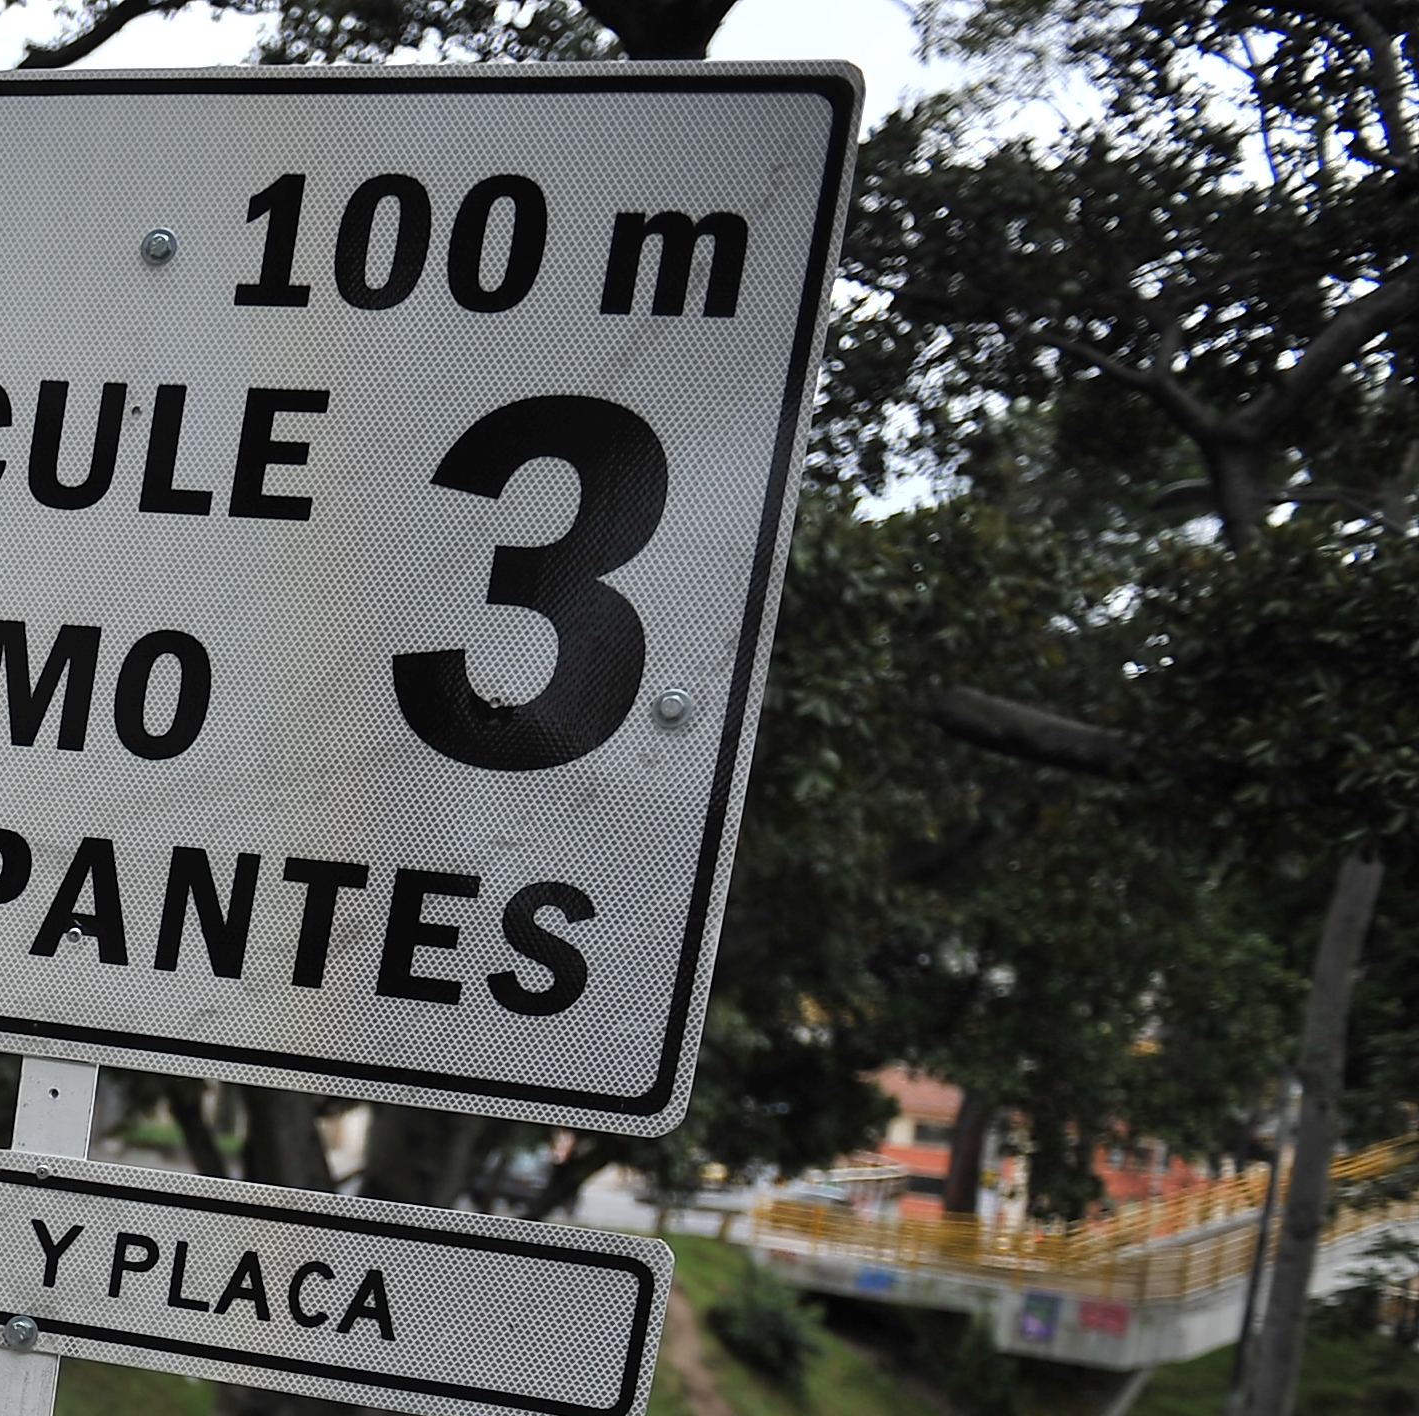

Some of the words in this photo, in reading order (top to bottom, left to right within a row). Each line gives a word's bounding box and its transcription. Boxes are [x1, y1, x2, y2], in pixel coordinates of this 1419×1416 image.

[233, 172, 550, 315] 100
[598, 209, 751, 319] m
[391, 393, 671, 773] 3
[30, 1217, 86, 1289] Y
[107, 1231, 397, 1343] PLACA
